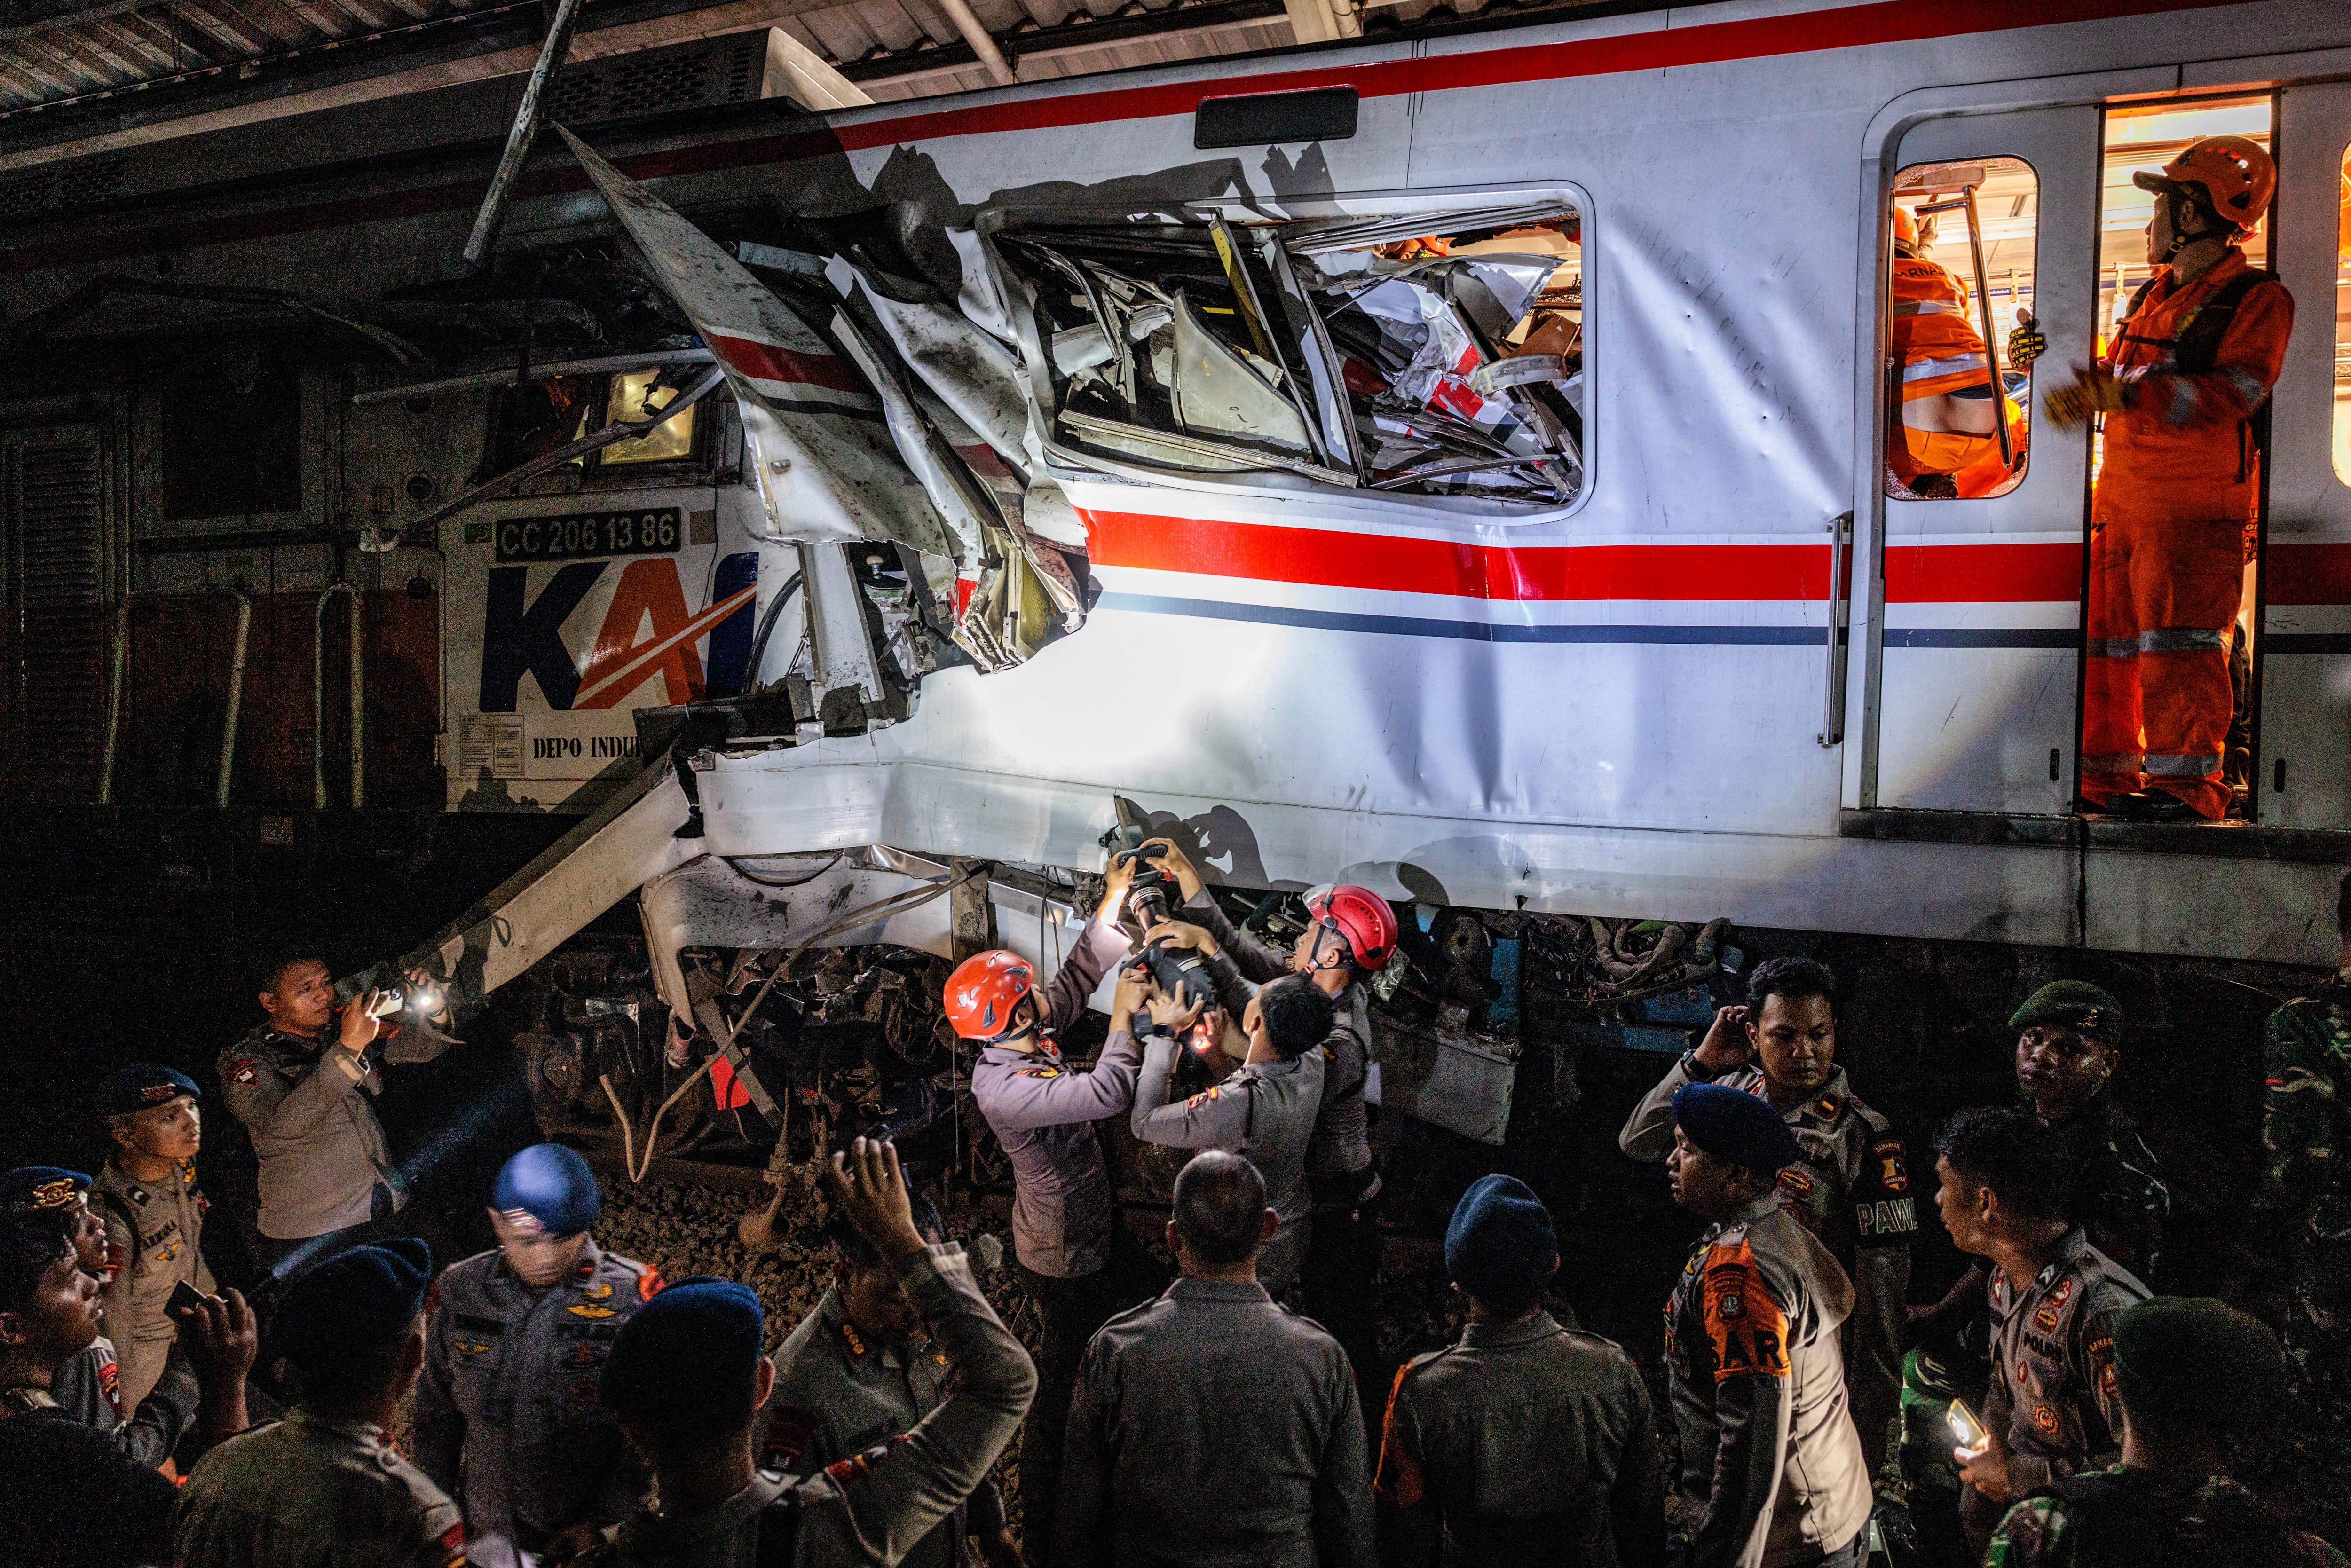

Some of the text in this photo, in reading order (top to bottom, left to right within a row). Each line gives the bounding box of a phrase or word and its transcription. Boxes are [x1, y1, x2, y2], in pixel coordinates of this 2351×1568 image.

[501, 522, 541, 555] CC
[549, 518, 597, 553] 206
[605, 517, 633, 549] 13
[641, 513, 675, 547] 86
[479, 552, 759, 713] KAI
[534, 737, 582, 758] DEPO
